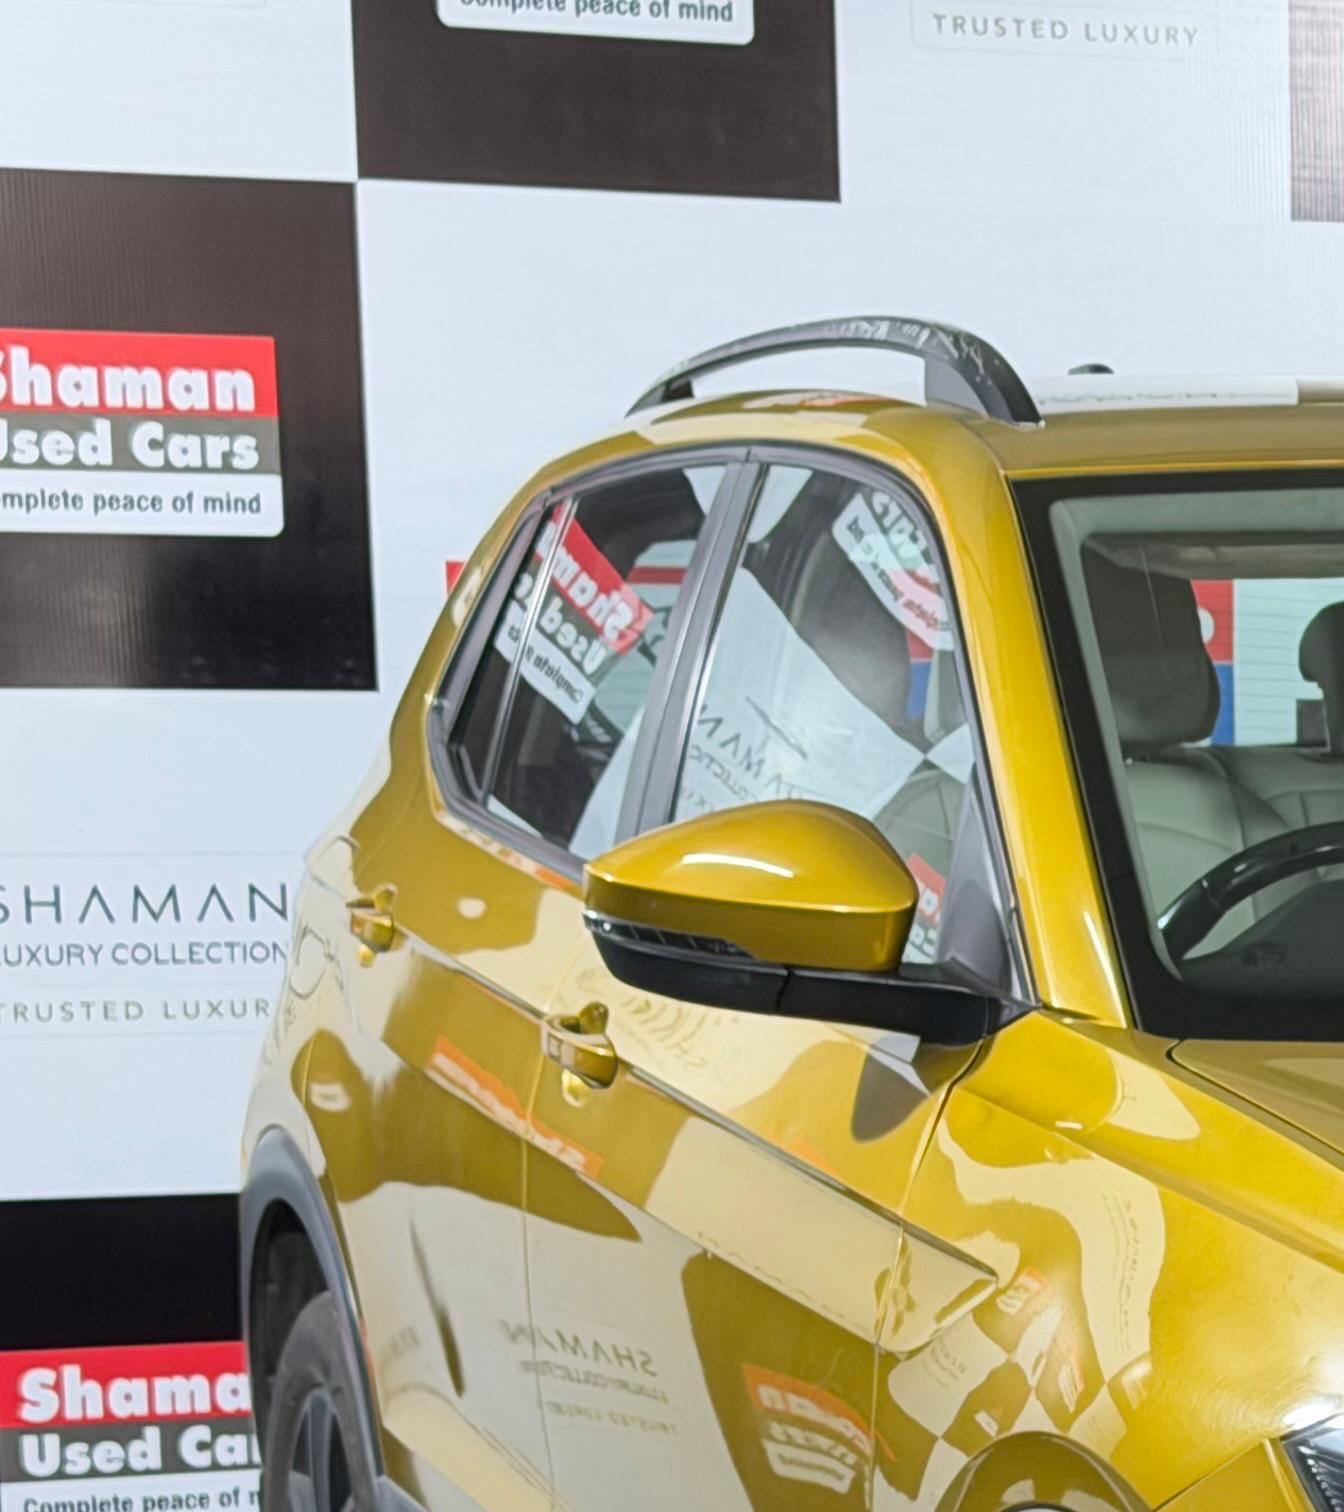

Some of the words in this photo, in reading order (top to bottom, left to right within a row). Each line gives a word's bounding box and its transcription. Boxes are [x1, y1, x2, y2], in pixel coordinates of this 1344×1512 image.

[649, 0, 669, 18] of
[678, 2, 733, 22] mind
[932, 13, 1068, 40] TRUSTED
[1084, 22, 1198, 46] LUXURY
[0, 416, 113, 466] sed
[131, 421, 259, 469] Cars
[0, 488, 84, 514] mplete
[93, 493, 163, 515] peace
[172, 491, 194, 513] of
[203, 492, 261, 513] mind
[0, 943, 103, 968] UXURY
[163, 999, 270, 1020] LUXUR
[20, 1364, 253, 1423] Shama
[21, 1425, 162, 1477] Used
[219, 1486, 240, 1507] of
